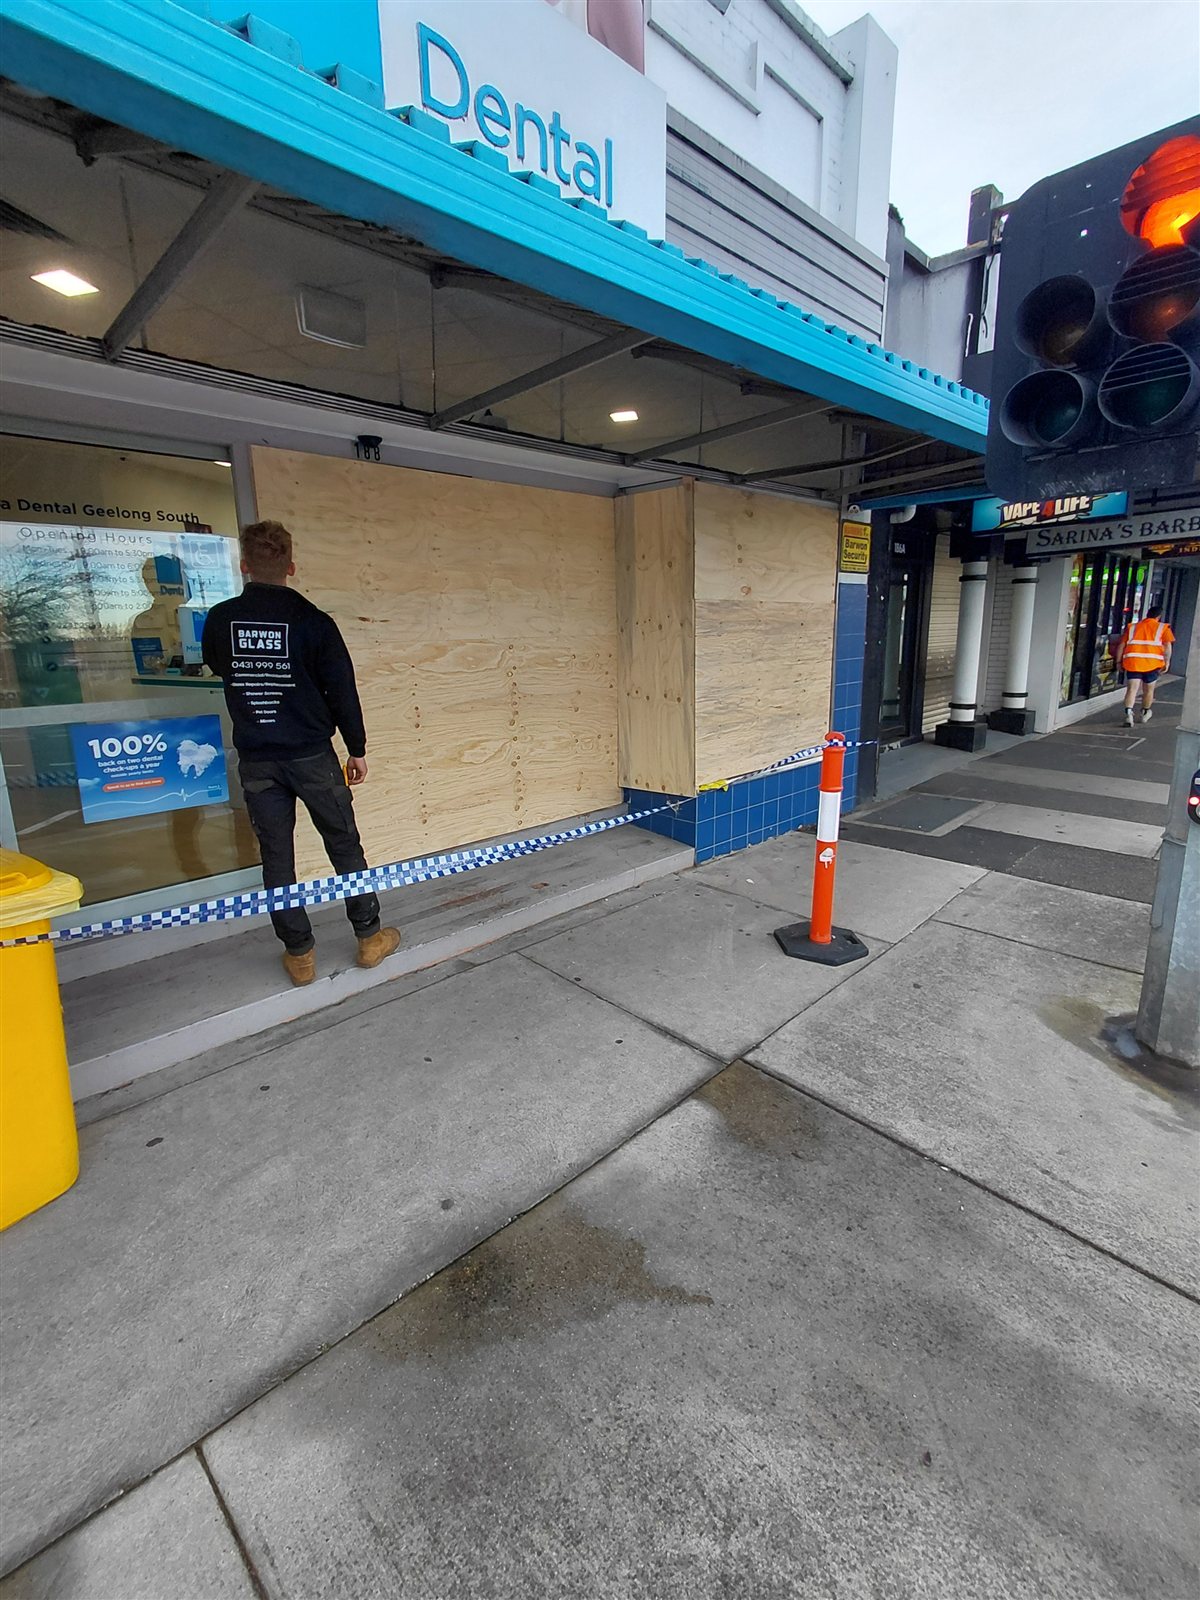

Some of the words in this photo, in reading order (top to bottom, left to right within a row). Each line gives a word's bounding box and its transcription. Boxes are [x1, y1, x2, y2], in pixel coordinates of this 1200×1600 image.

[417, 21, 613, 208] Dental
[354, 441, 381, 461] 188
[17, 499, 77, 515] Dental
[83, 505, 151, 522] Geelong
[156, 510, 200, 524] South
[20, 527, 96, 543] Opening
[105, 532, 153, 544] Hours
[1036, 523, 1133, 547] SARINA'S
[845, 539, 867, 550] Barwon
[843, 549, 867, 561] Security
[238, 630, 281, 639] BARWON
[239, 638, 281, 650] GLASS
[231, 661, 253, 669] 0431
[255, 661, 274, 669] 999
[275, 662, 290, 670] 561
[88, 733, 167, 759] 100%
[103, 764, 138, 774] check-ups
